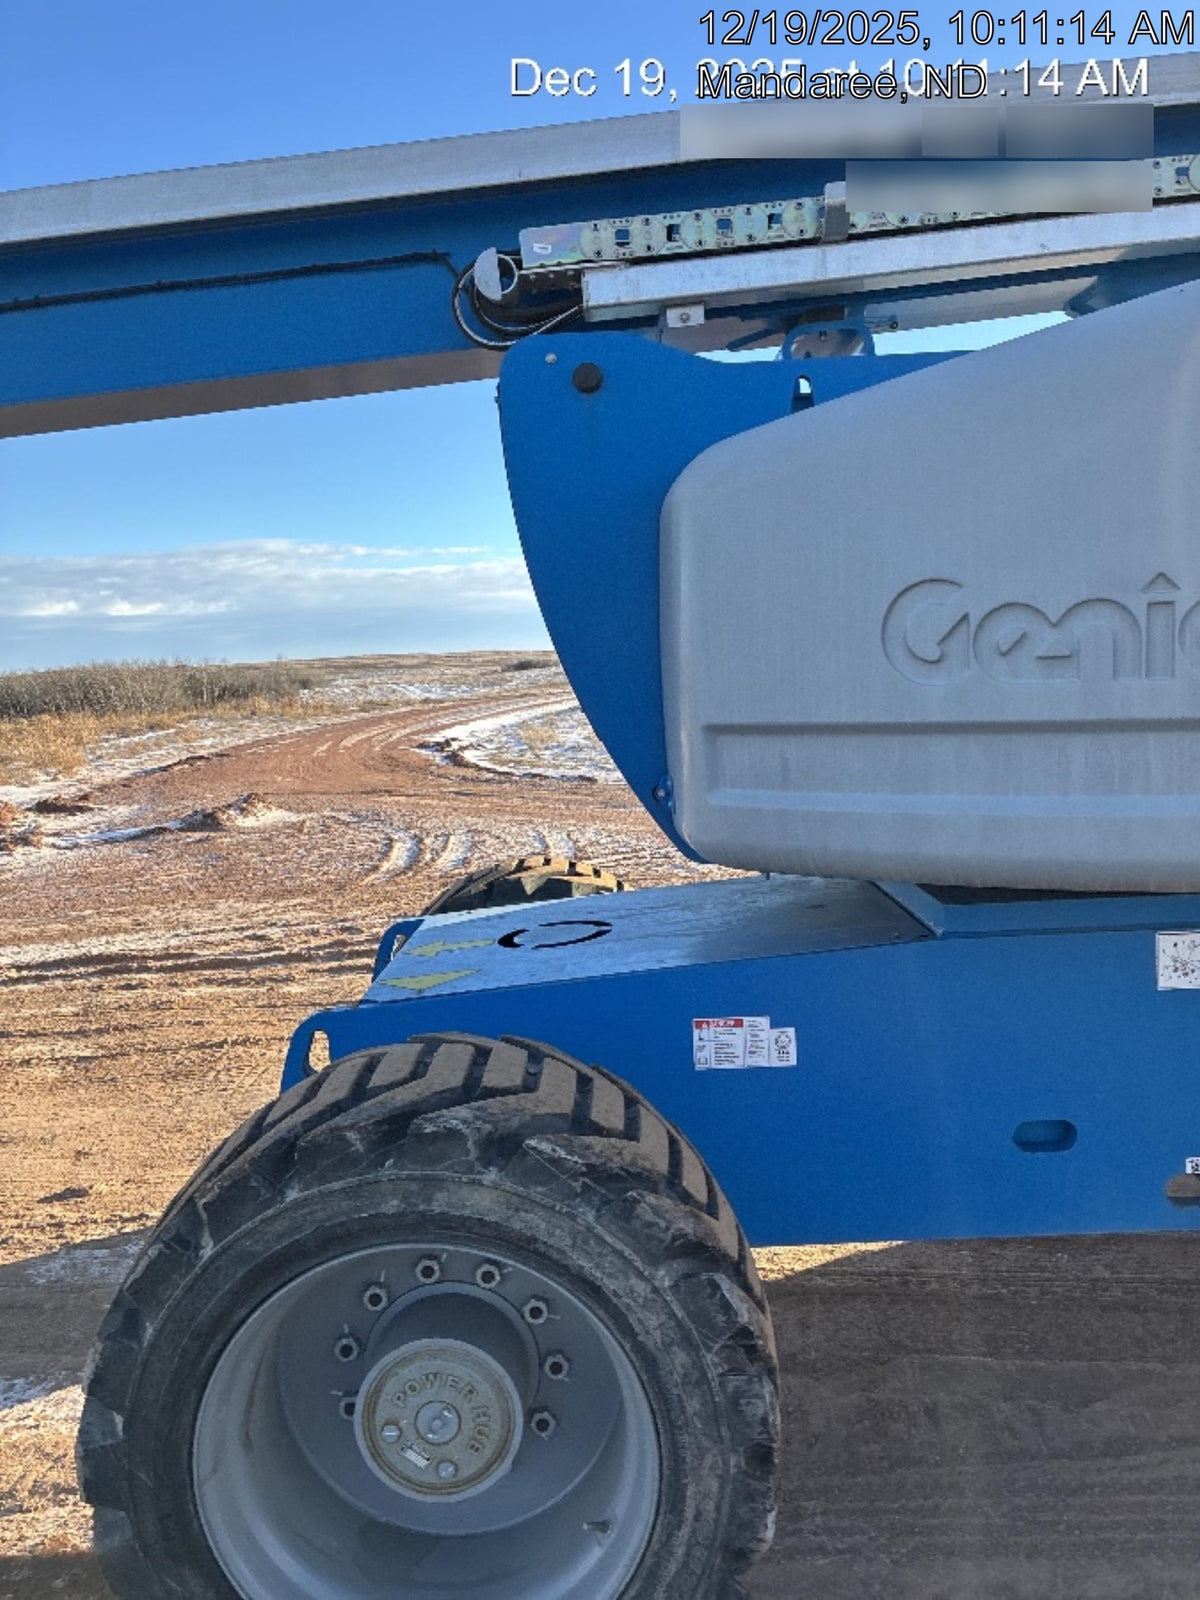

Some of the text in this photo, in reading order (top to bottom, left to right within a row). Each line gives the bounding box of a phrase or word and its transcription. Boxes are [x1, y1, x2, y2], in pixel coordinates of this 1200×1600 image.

[881, 572, 1200, 686] Geni
[392, 1372, 479, 1407] POWER
[468, 1404, 491, 1455] HUB
